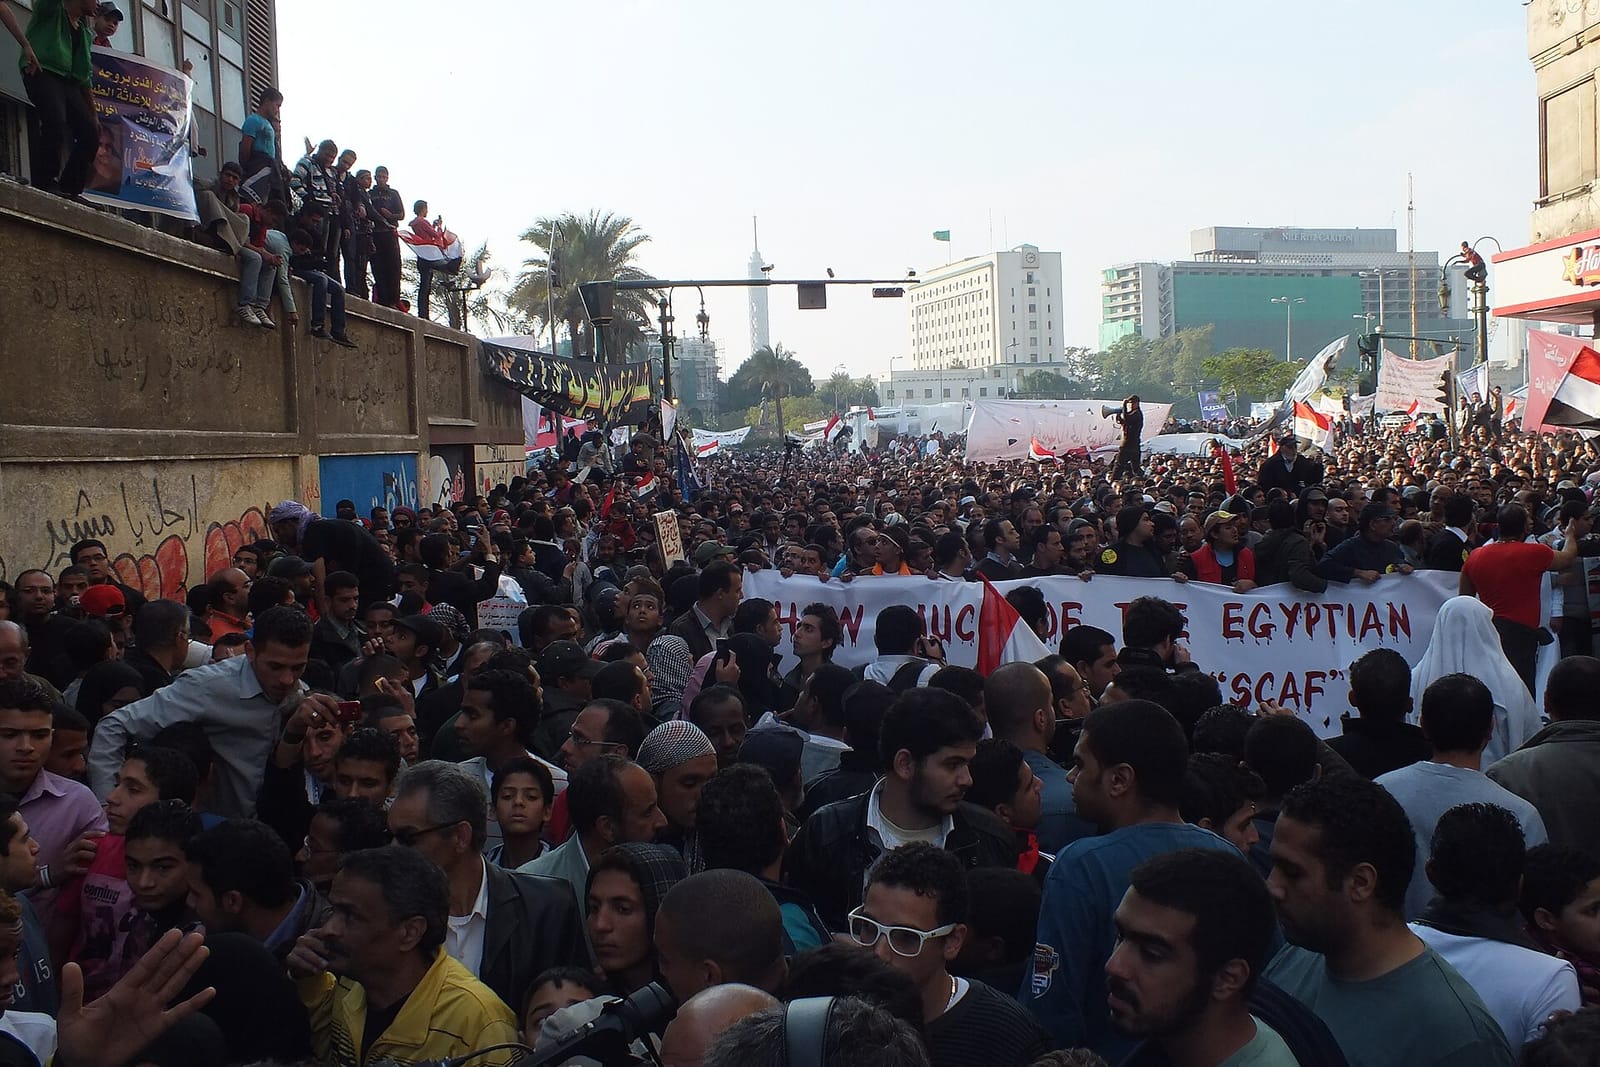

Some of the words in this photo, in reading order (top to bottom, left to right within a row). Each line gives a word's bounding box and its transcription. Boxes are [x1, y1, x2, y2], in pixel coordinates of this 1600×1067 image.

[121, 482, 143, 547] يا
[147, 474, 199, 542] ارحل
[774, 601, 864, 648] HW
[1222, 601, 1412, 645] EGYPTIAN
[34, 958, 51, 983] 15
